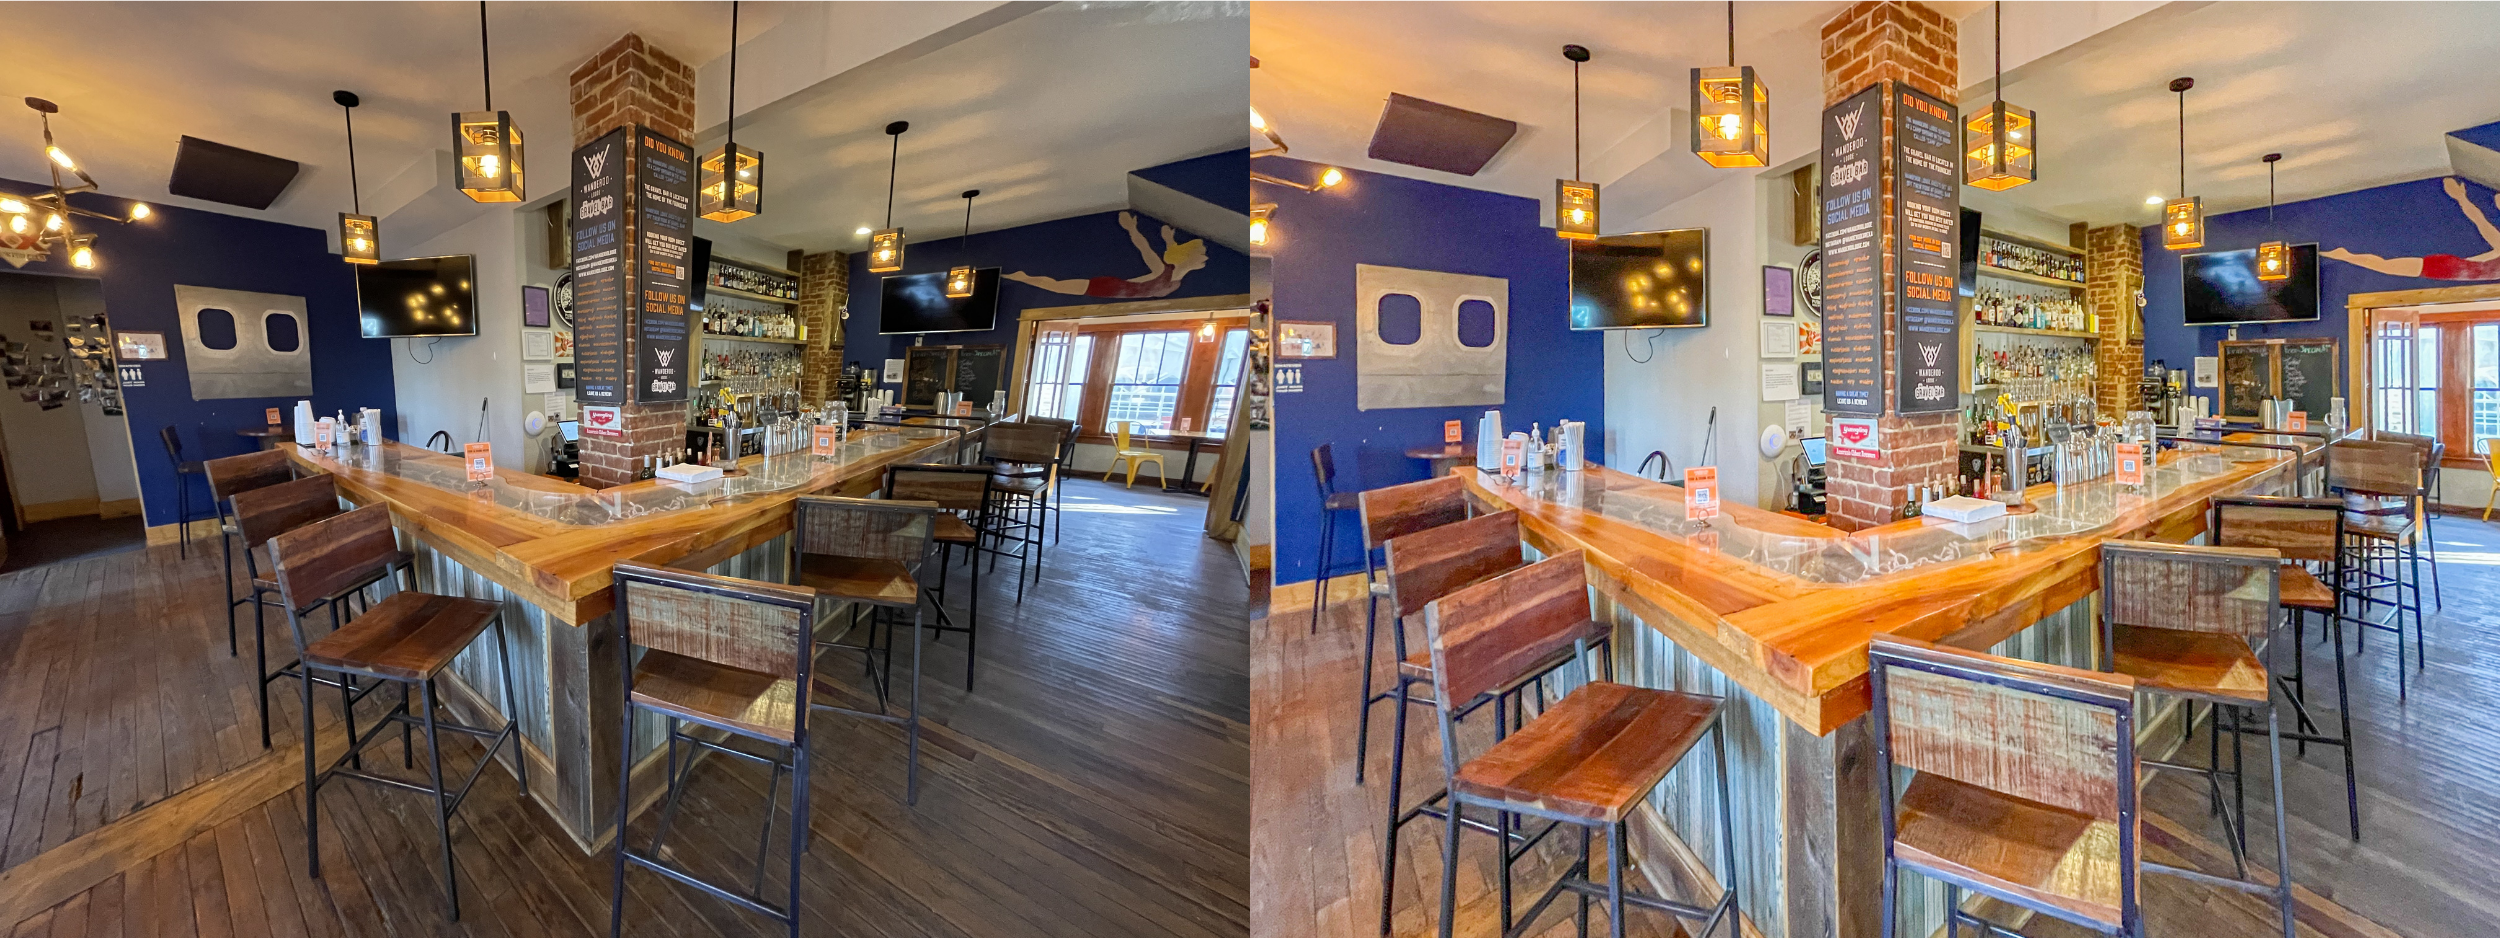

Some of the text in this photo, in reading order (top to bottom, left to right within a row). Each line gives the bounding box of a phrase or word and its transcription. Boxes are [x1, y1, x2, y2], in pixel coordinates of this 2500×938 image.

[1903, 92, 1914, 108] DID
[1915, 97, 1928, 113] YOU
[645, 136, 655, 149] DID
[656, 140, 667, 154] YOU
[1835, 137, 1864, 157] WANDEROO
[1831, 163, 1854, 187] GRAVEL
[1826, 187, 1871, 212] FOLLOW US ON
[1828, 202, 1869, 225] SOCIAL MEDIA
[577, 219, 616, 241] FOLLOW US ON
[578, 232, 615, 252] SOCIAL MEDIA
[1905, 271, 1953, 289] FOLLOW US ON
[645, 290, 686, 305] FOLLOW US ON
[1907, 286, 1952, 302] SOCIAL MEDIA
[646, 302, 684, 315] SOCIAL MEDIA
[592, 411, 613, 420] Yuengling
[1843, 426, 1869, 436] Yuengling
